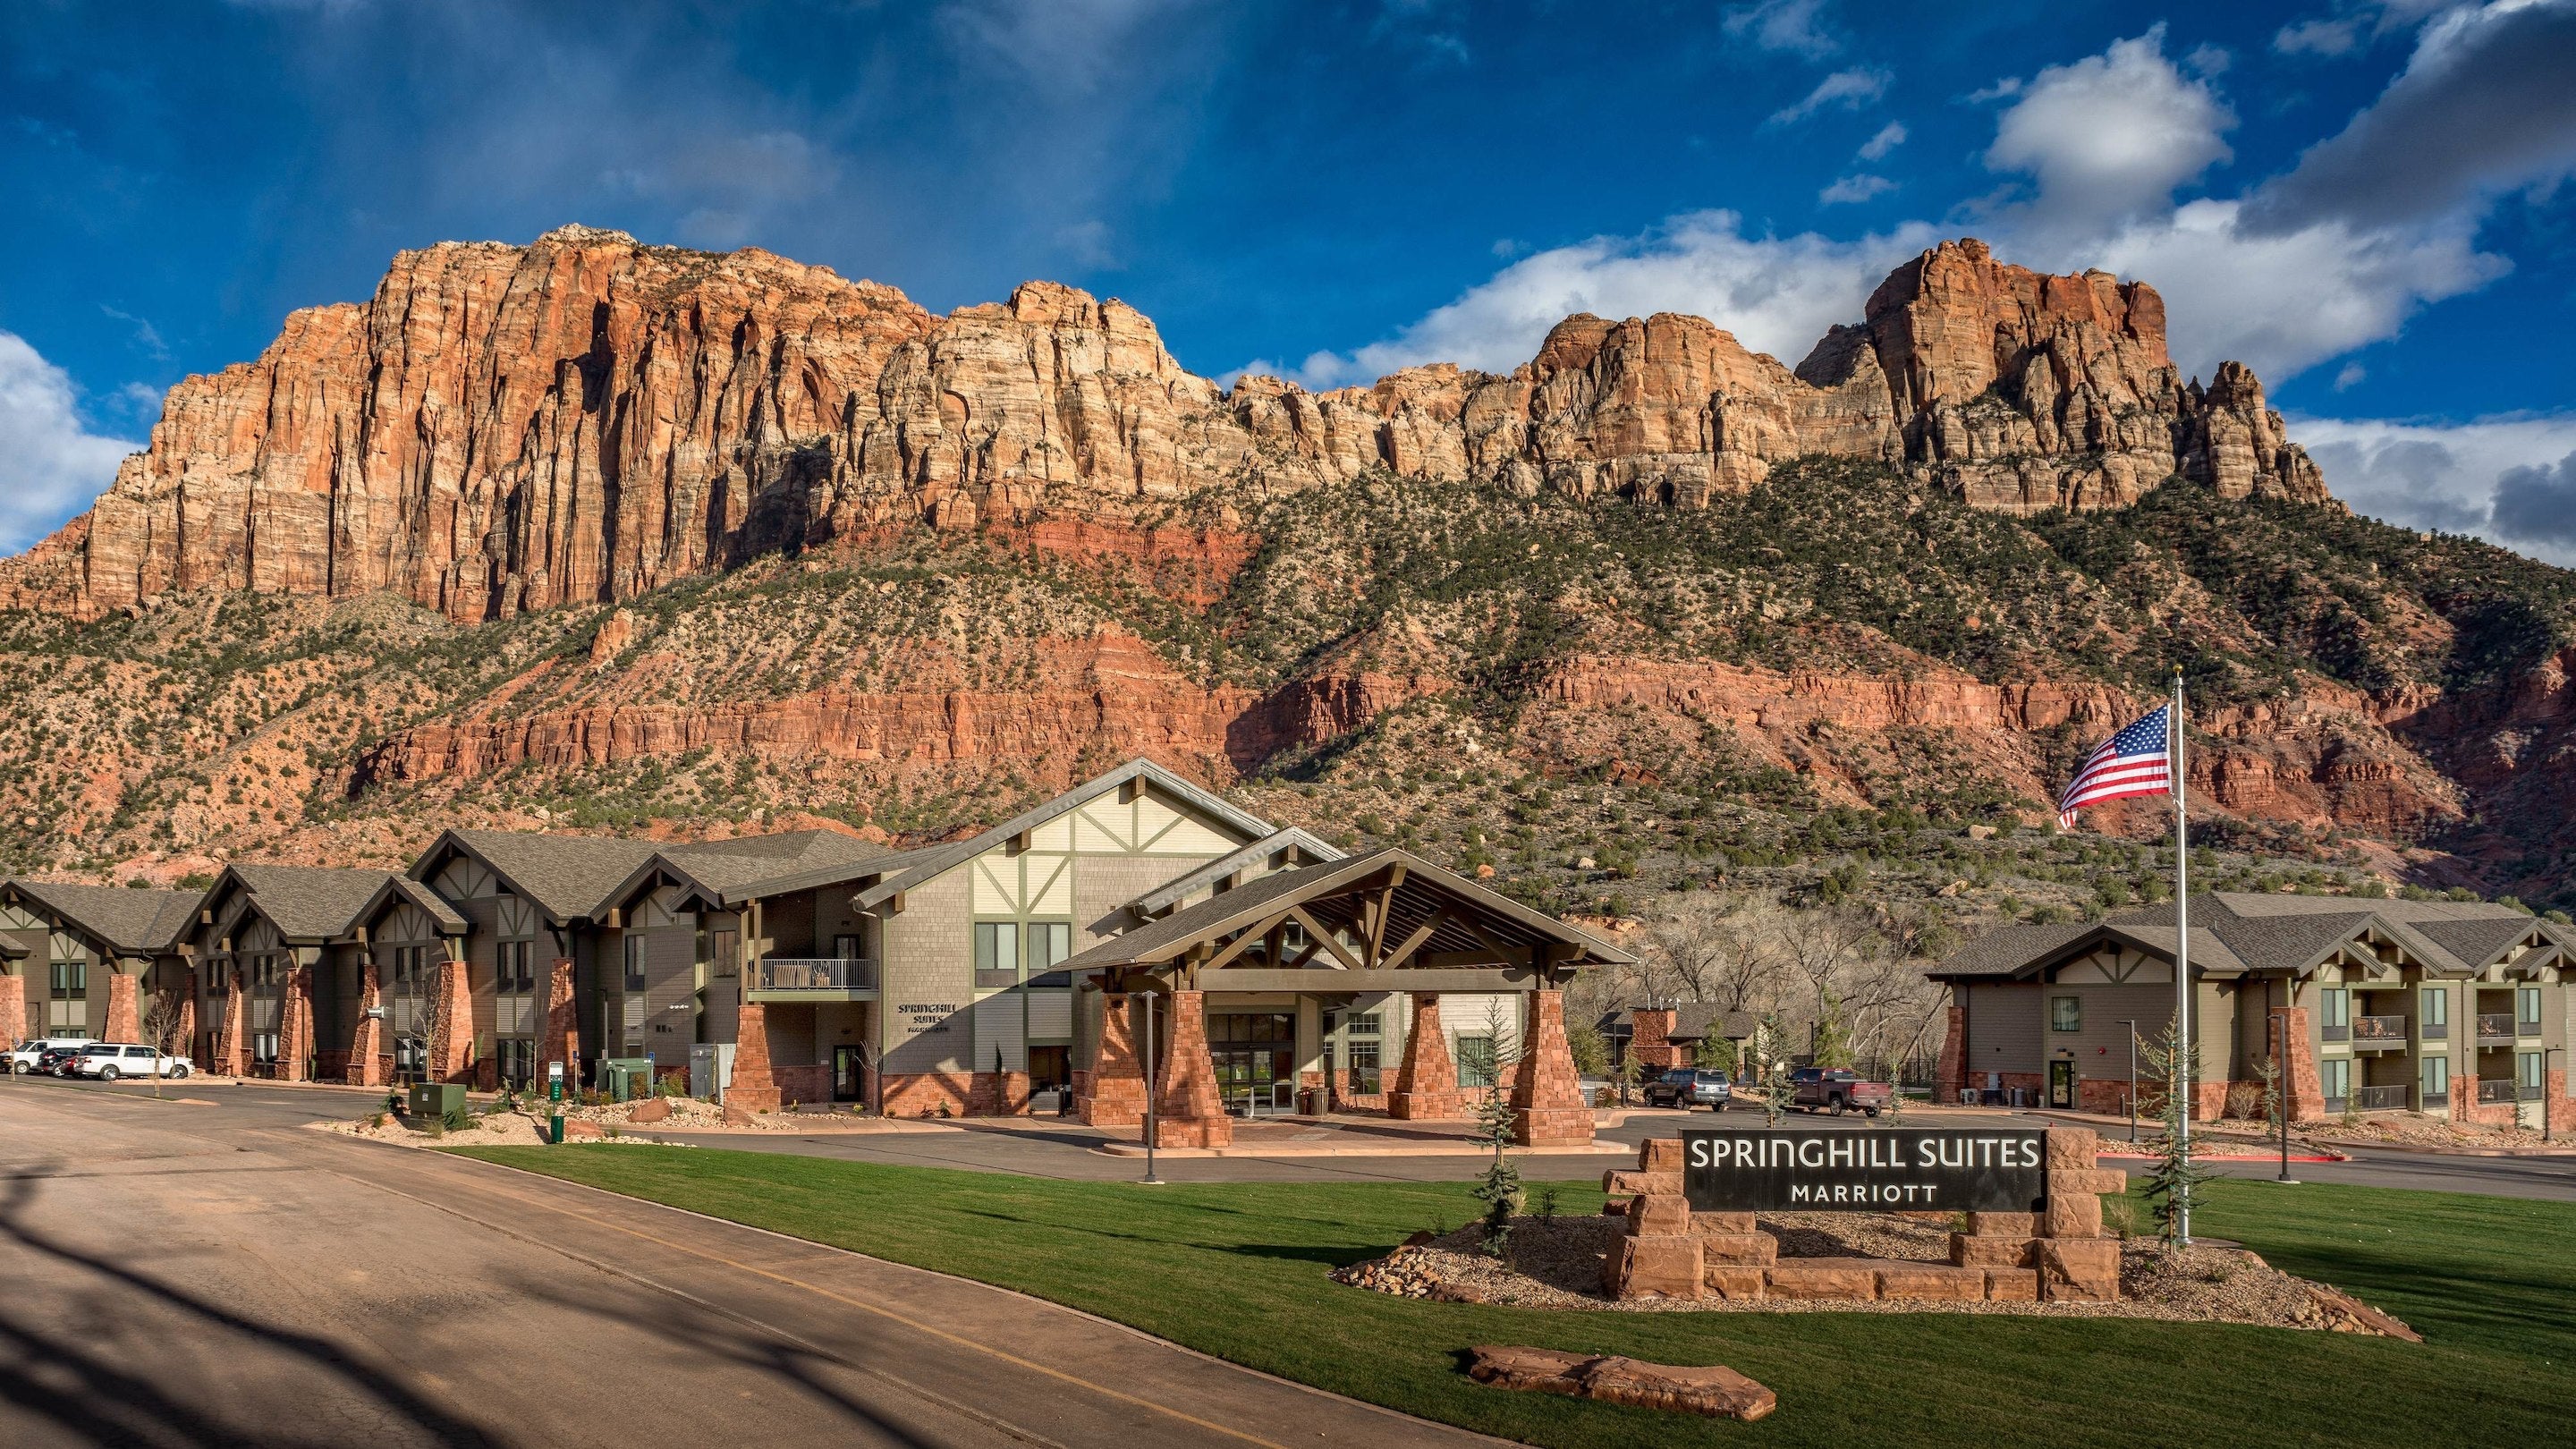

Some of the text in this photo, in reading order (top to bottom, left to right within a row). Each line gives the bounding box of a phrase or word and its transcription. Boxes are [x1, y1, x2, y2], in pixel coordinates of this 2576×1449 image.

[898, 1004, 956, 1013] SPRINGHILL
[1690, 1139, 2040, 1168] SPRINGHILL SUITES
[1792, 1185, 1937, 1202] MARRIOTT
